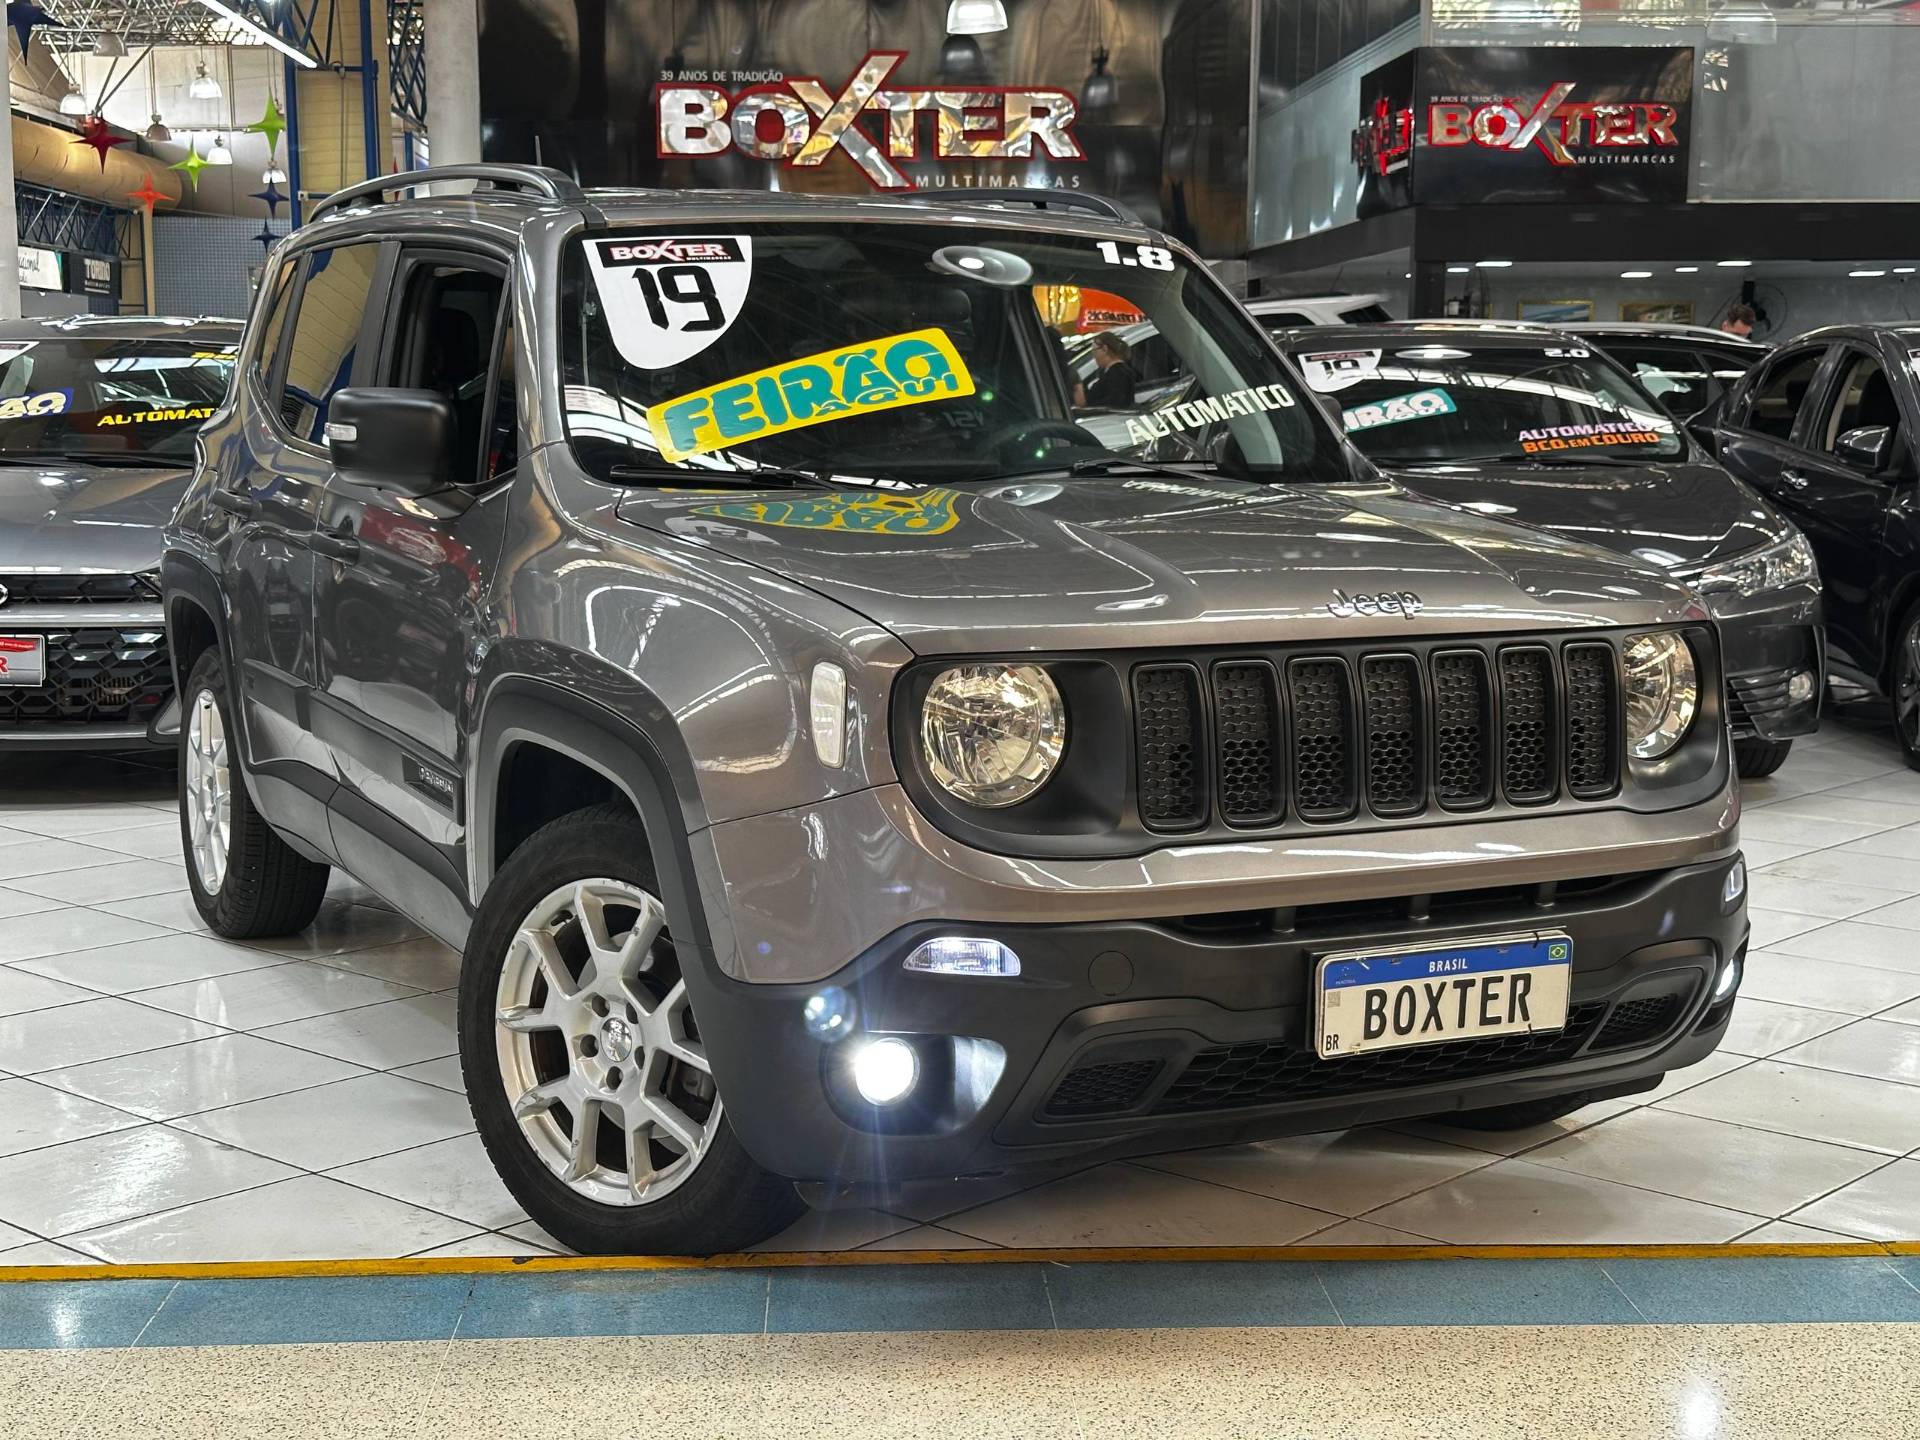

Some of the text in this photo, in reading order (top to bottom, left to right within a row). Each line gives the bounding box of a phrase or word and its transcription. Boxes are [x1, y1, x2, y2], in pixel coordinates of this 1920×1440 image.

[661, 69, 784, 84] 39 ANOS DE TRADIÇÃO
[656, 49, 1088, 191] BOXTER
[1428, 81, 1679, 167] BOXTER
[1577, 154, 1676, 165] MULTIMARCAS
[915, 174, 1081, 189] MULTIMARCAS
[609, 239, 730, 262] BOXTER
[1096, 241, 1176, 272] 1.8
[631, 265, 726, 332] 19
[1544, 348, 1590, 358] 2.0
[664, 339, 952, 452] FEIRÃO
[97, 407, 216, 427] AUTOMAT
[1591, 432, 1660, 446] COURO
[1326, 588, 1423, 620] Jeep
[1428, 958, 1468, 973] BRASIL
[1363, 973, 1532, 1040] BOXTER
[1325, 1034, 1339, 1051] BR
